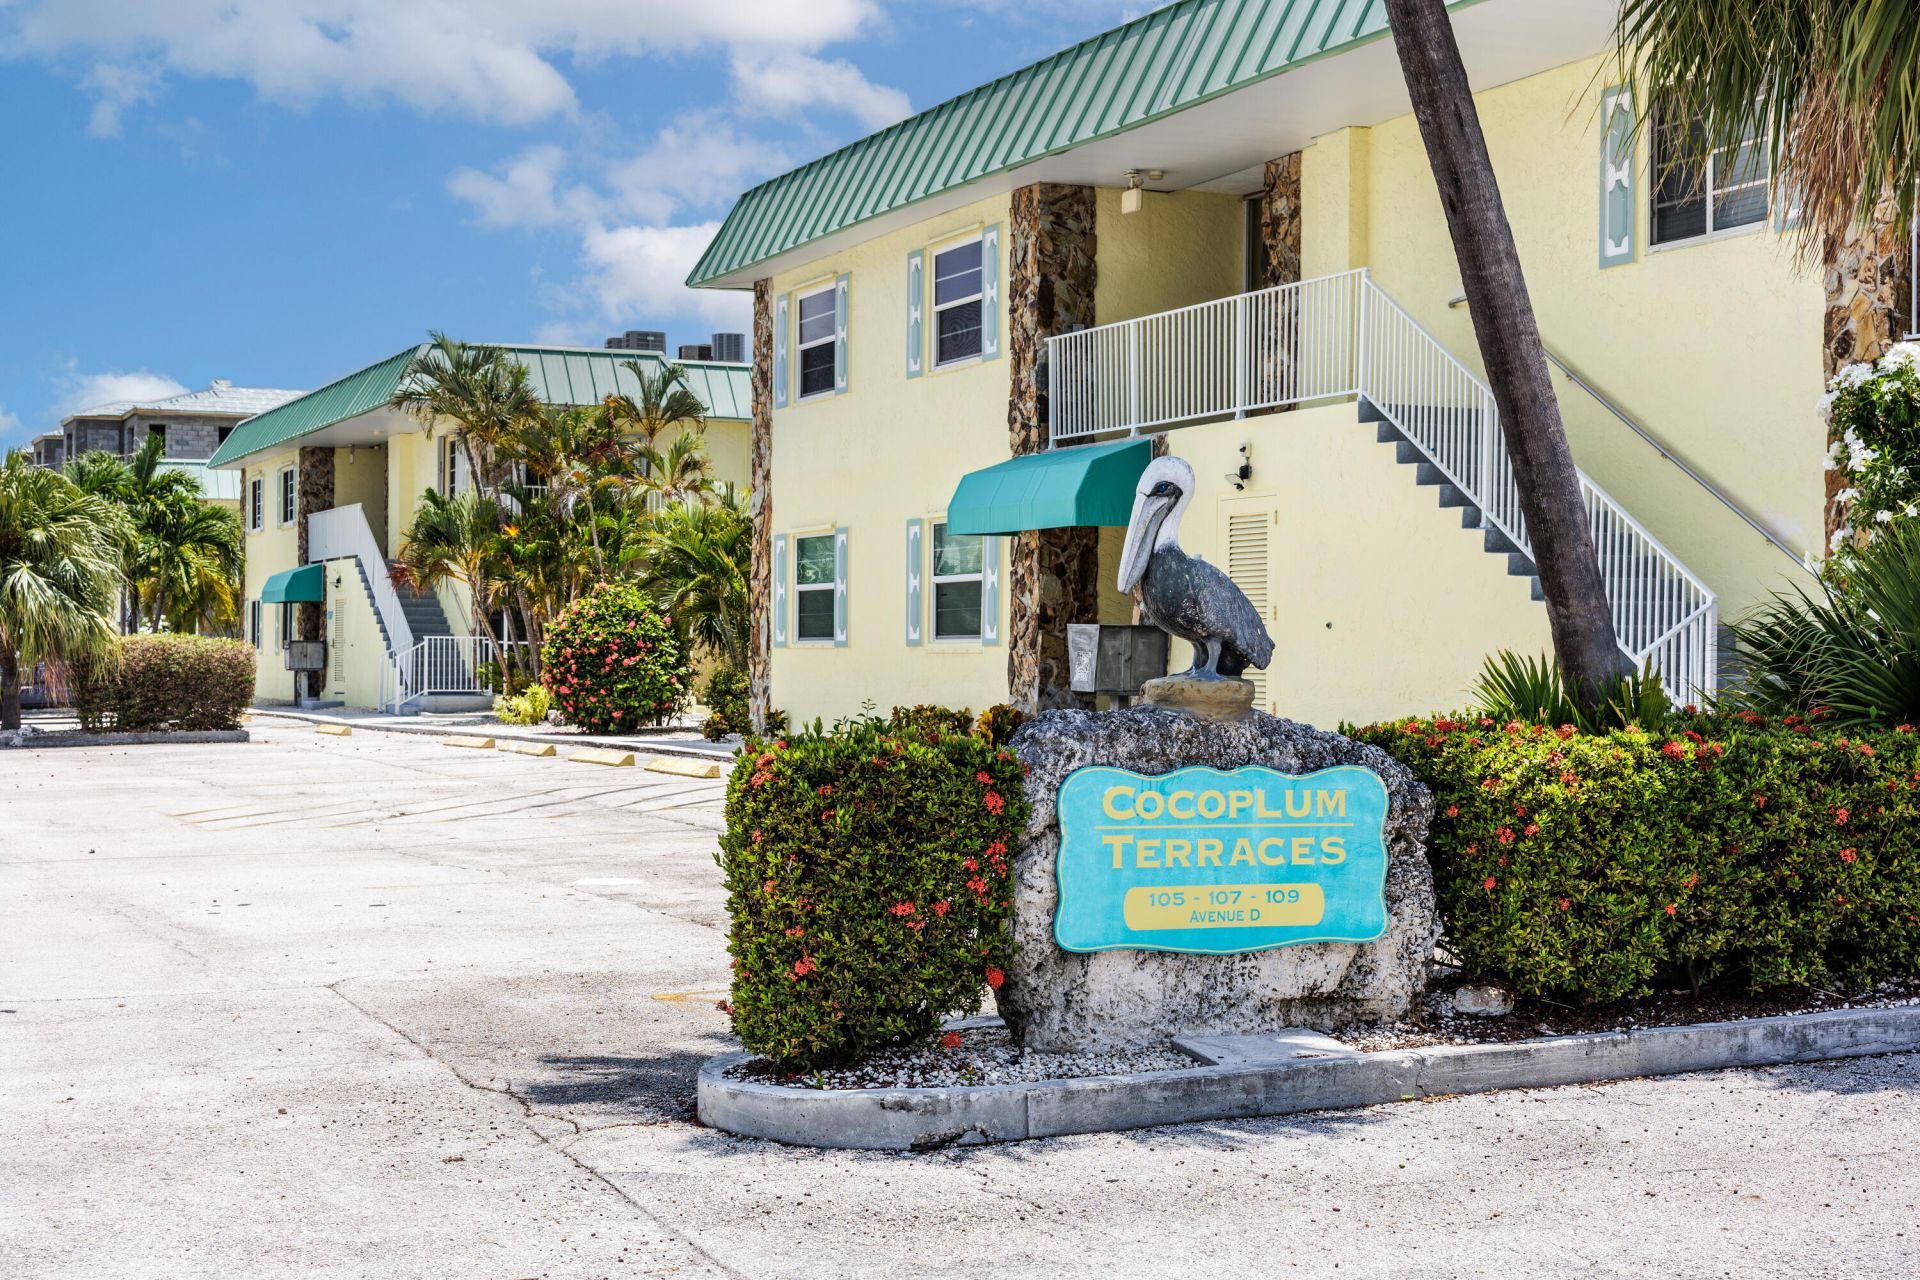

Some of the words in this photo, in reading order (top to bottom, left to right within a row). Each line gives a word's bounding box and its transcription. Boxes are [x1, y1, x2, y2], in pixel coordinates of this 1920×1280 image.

[1102, 785, 1347, 821] COCOPLUM
[1102, 834, 1347, 869] TERRACES
[1149, 891, 1185, 907] 105
[1208, 890, 1242, 905] 107
[1265, 889, 1300, 904] 109
[1189, 909, 1245, 923] AVENUE
[1250, 908, 1261, 922] D
